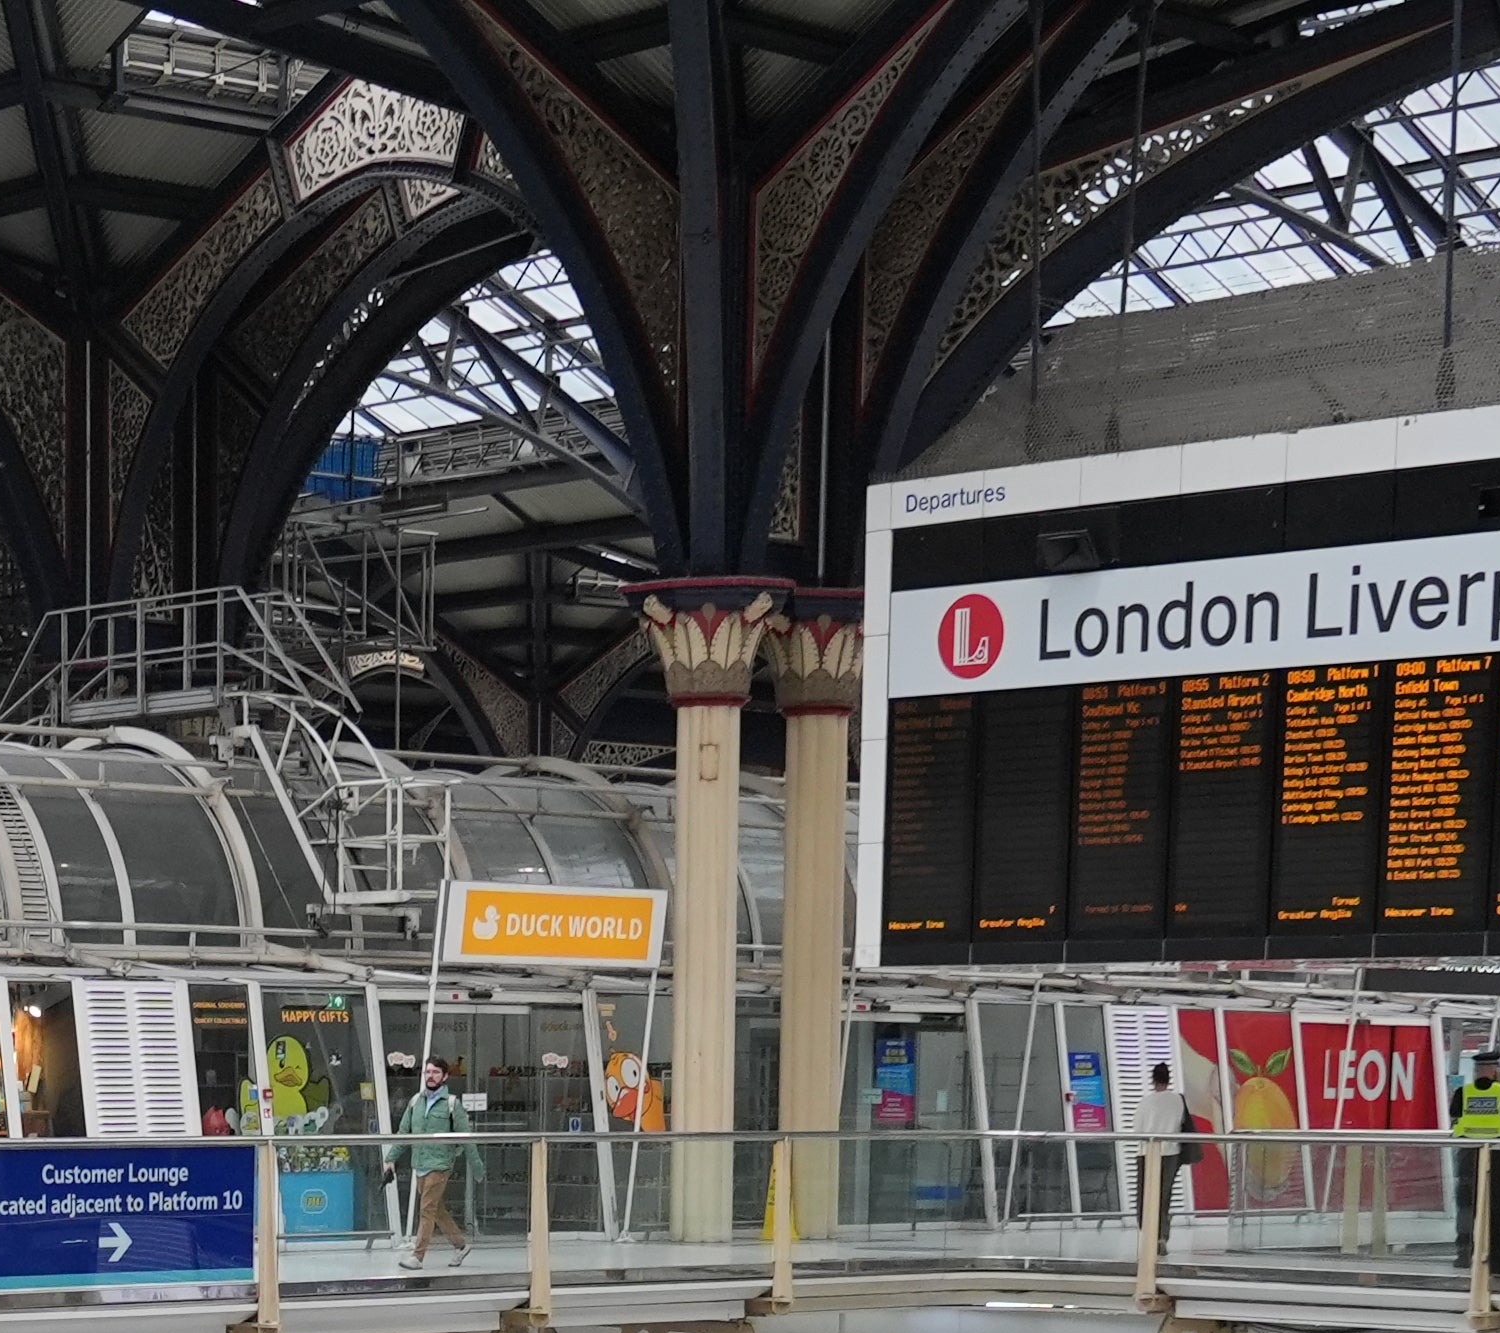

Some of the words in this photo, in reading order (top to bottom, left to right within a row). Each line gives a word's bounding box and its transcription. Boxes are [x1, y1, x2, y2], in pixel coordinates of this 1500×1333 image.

[905, 483, 1006, 514] Departures
[1039, 581, 1280, 661] London
[1436, 658, 1481, 674] Platform
[1484, 656, 1493, 670] 7
[1286, 688, 1335, 703] Cambridge
[1395, 680, 1430, 696] Enfield
[1433, 679, 1460, 693] Town
[505, 913, 563, 938] DUCK
[568, 914, 643, 940] WORLD
[281, 1011, 315, 1022] HAPPY
[318, 1011, 349, 1022] GIFTS
[1323, 1049, 1414, 1101] LEON
[42, 1162, 122, 1186] Customer
[128, 1163, 189, 1189] Lounge
[45, 1190, 119, 1218] adjacent
[125, 1193, 143, 1211] to
[148, 1190, 216, 1213] Platform
[223, 1190, 242, 1211] 10
